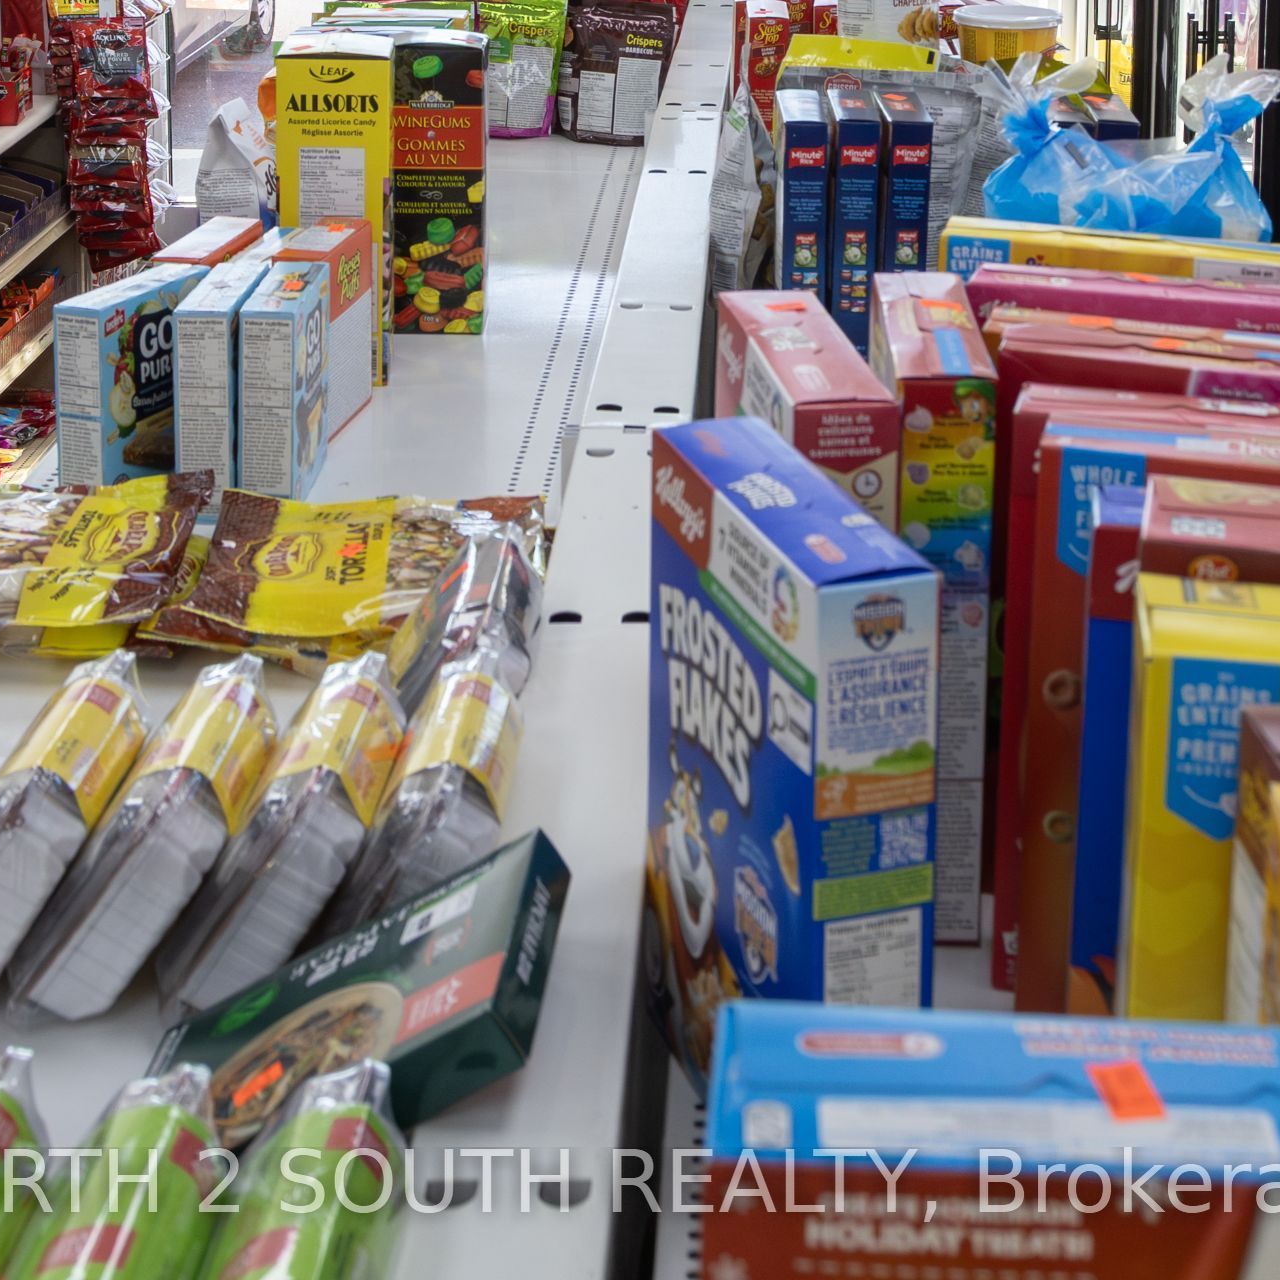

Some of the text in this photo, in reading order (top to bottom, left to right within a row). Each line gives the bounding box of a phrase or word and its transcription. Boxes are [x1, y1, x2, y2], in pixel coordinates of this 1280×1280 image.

[508, 21, 554, 37] Crispers
[757, 23, 785, 37] Stove
[626, 33, 663, 48] Crispers
[761, 32, 780, 45] Top
[320, 65, 349, 76] LEAF
[285, 93, 379, 113] ALLSORTS
[287, 118, 377, 127] Assorted Licorice Candy
[301, 128, 364, 137] Réglisse Assortie
[397, 138, 465, 151] GOMMES
[405, 153, 458, 165] AU VIN
[791, 150, 822, 159] Minute
[842, 149, 873, 158] Minute
[895, 148, 926, 157] Minute
[951, 245, 1005, 262] GRAINS
[1069, 463, 1138, 487] WHOLE
[655, 464, 707, 544] Kellogg's
[658, 583, 764, 742] FROSTED
[827, 676, 929, 706] L'ASSURANCE
[1179, 683, 1272, 706] GRAINS
[840, 697, 928, 726] RÉSILIENCE
[669, 652, 752, 810] FLAKES
[804, 1219, 962, 1256] HOLIDAY
